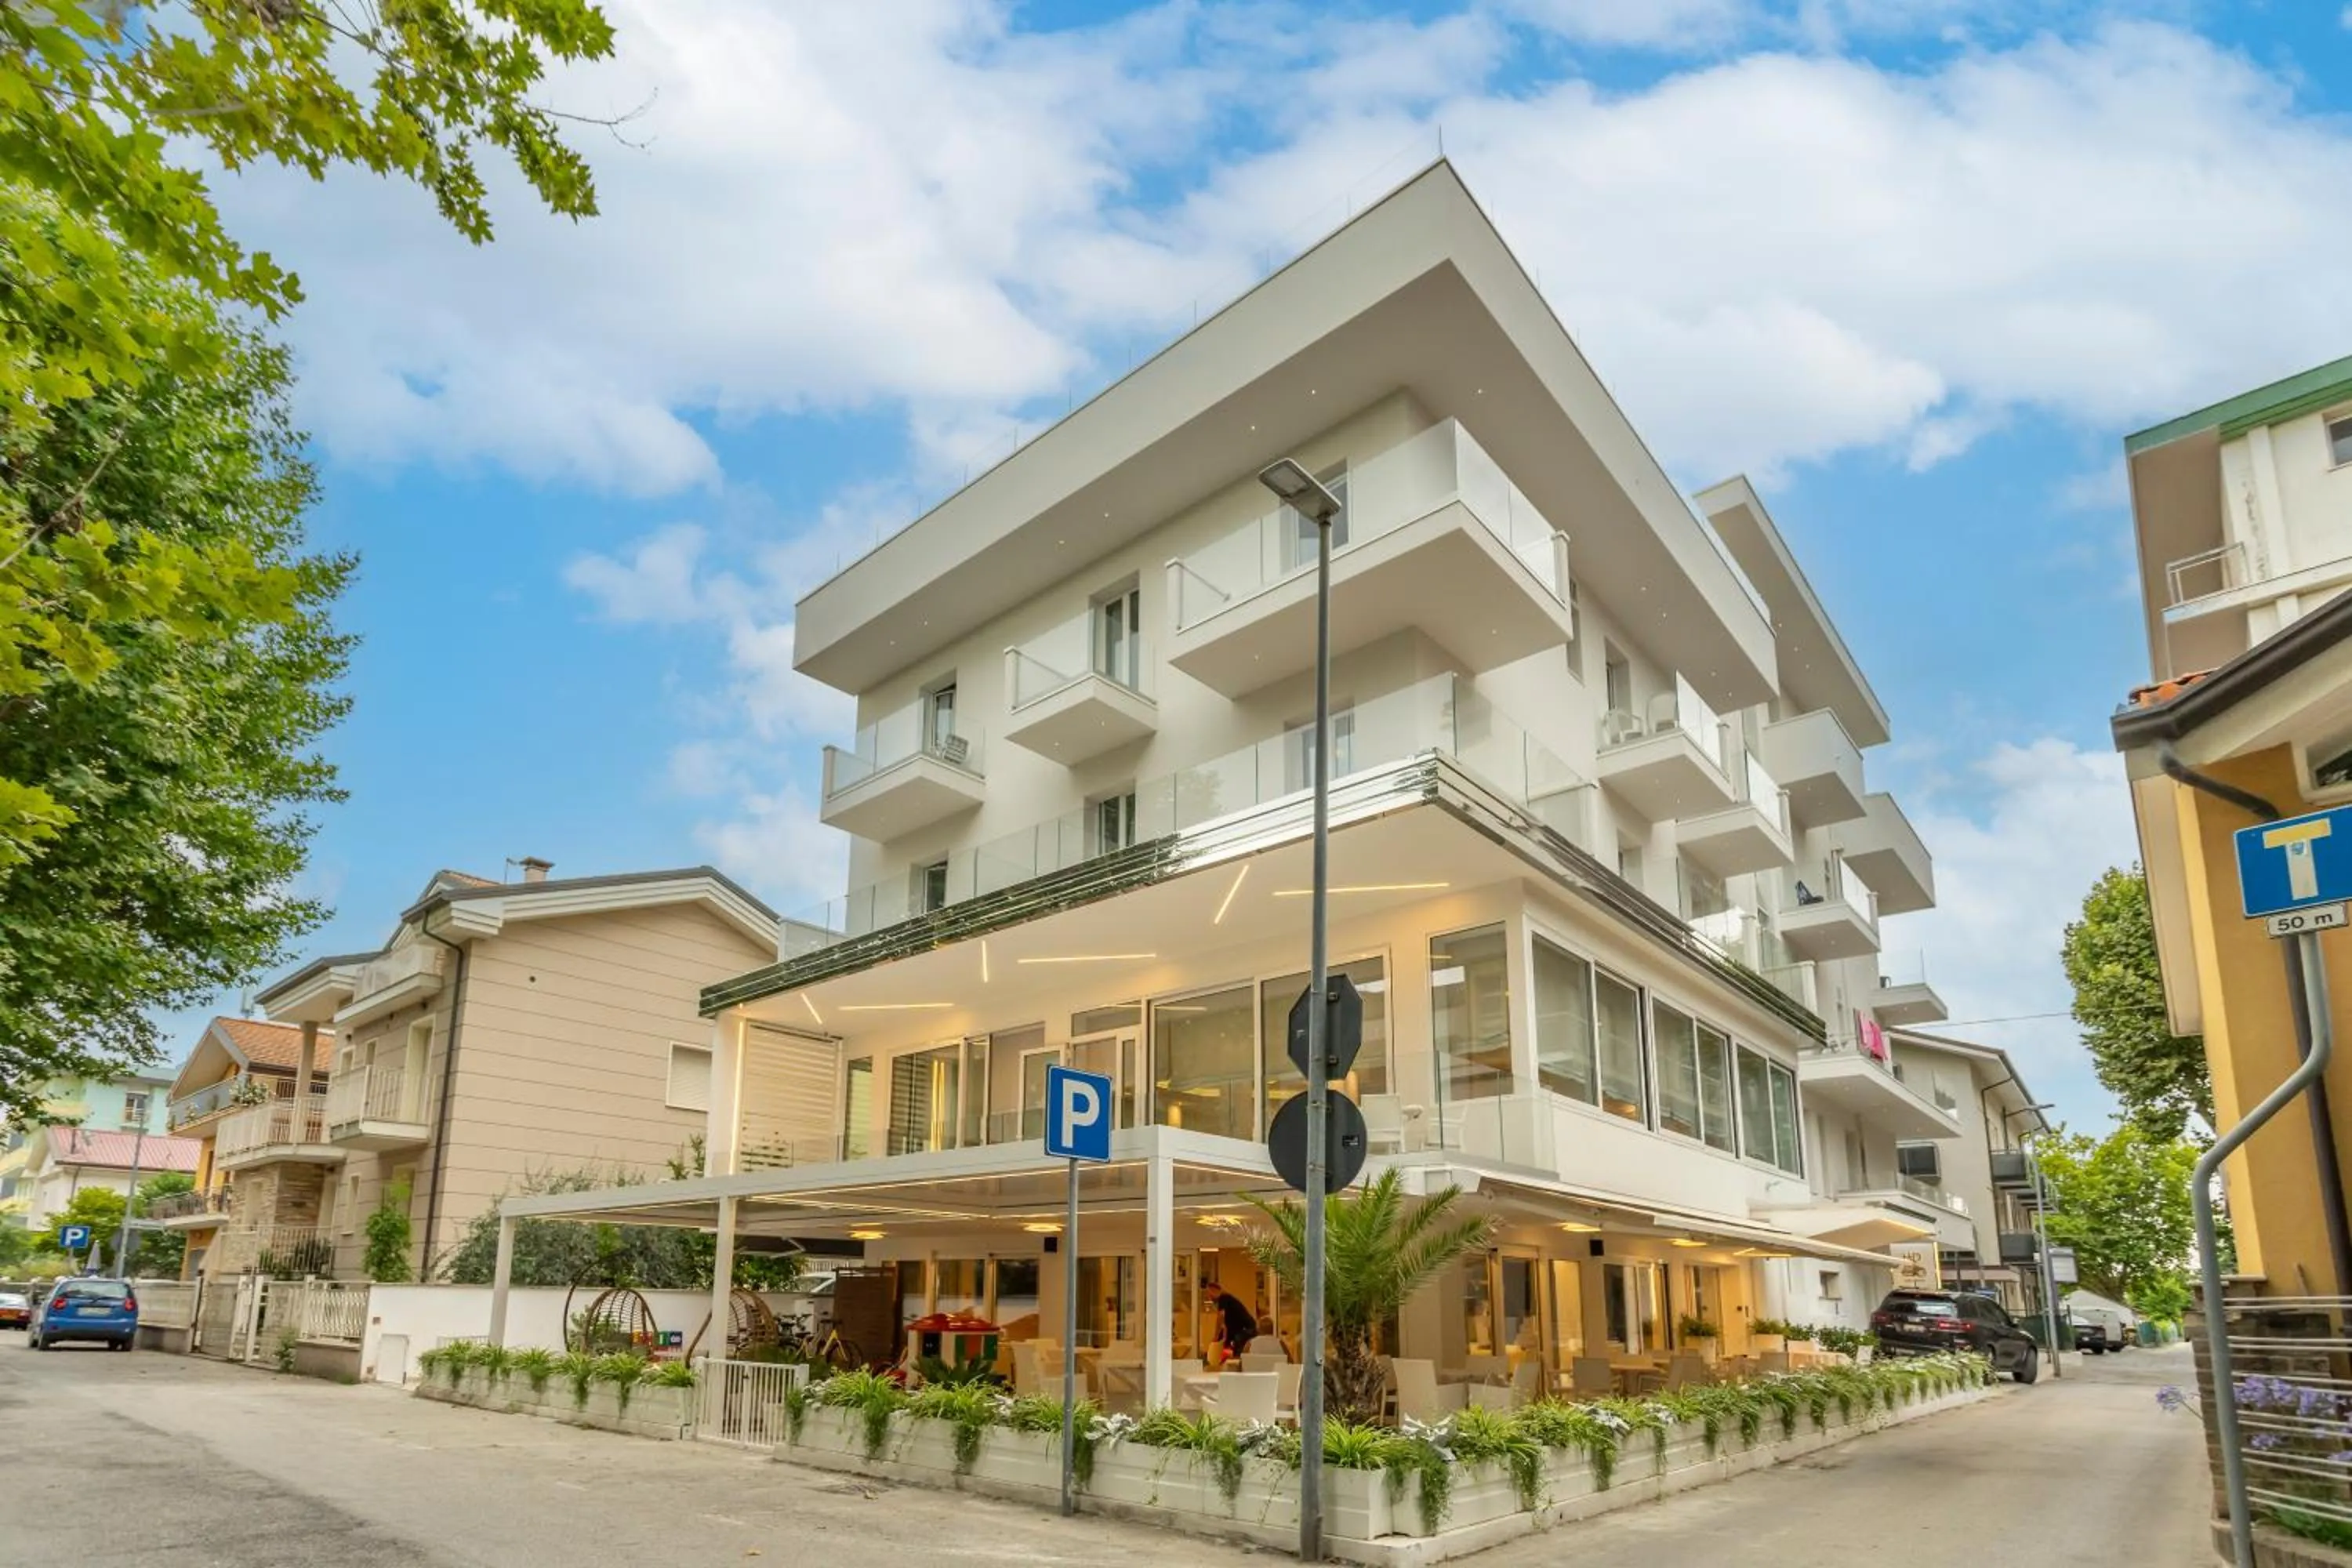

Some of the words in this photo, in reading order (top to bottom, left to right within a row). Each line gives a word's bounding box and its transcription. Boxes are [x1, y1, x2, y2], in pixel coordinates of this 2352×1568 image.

[2278, 916, 2304, 931] 50
[2314, 913, 2333, 925] m
[1062, 1078, 1099, 1149] P
[65, 1229, 84, 1245] P
